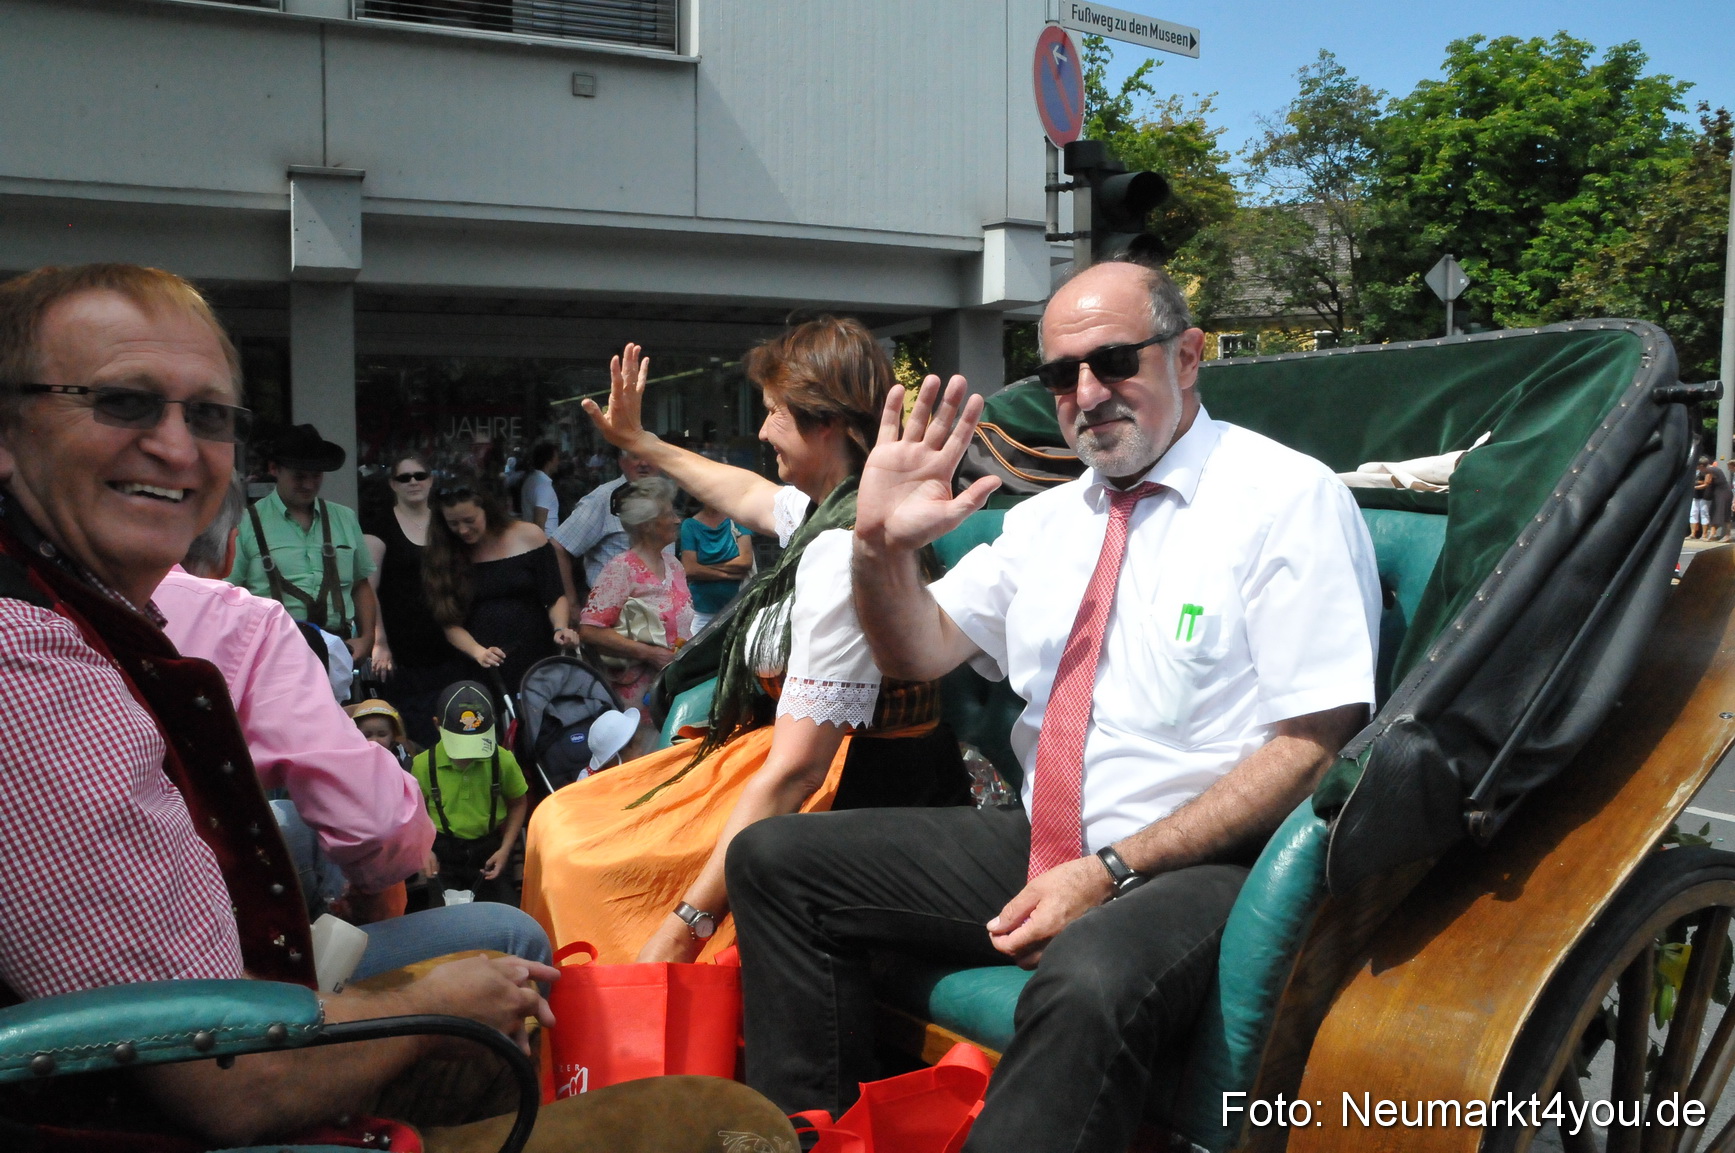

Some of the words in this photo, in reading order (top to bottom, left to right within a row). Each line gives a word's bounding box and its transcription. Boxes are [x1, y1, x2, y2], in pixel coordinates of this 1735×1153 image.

[1072, 4, 1113, 33] Fußweg
[1115, 18, 1127, 31] zu
[1129, 18, 1148, 36] den
[1150, 23, 1188, 48] Museen
[444, 416, 522, 440] JAHRE
